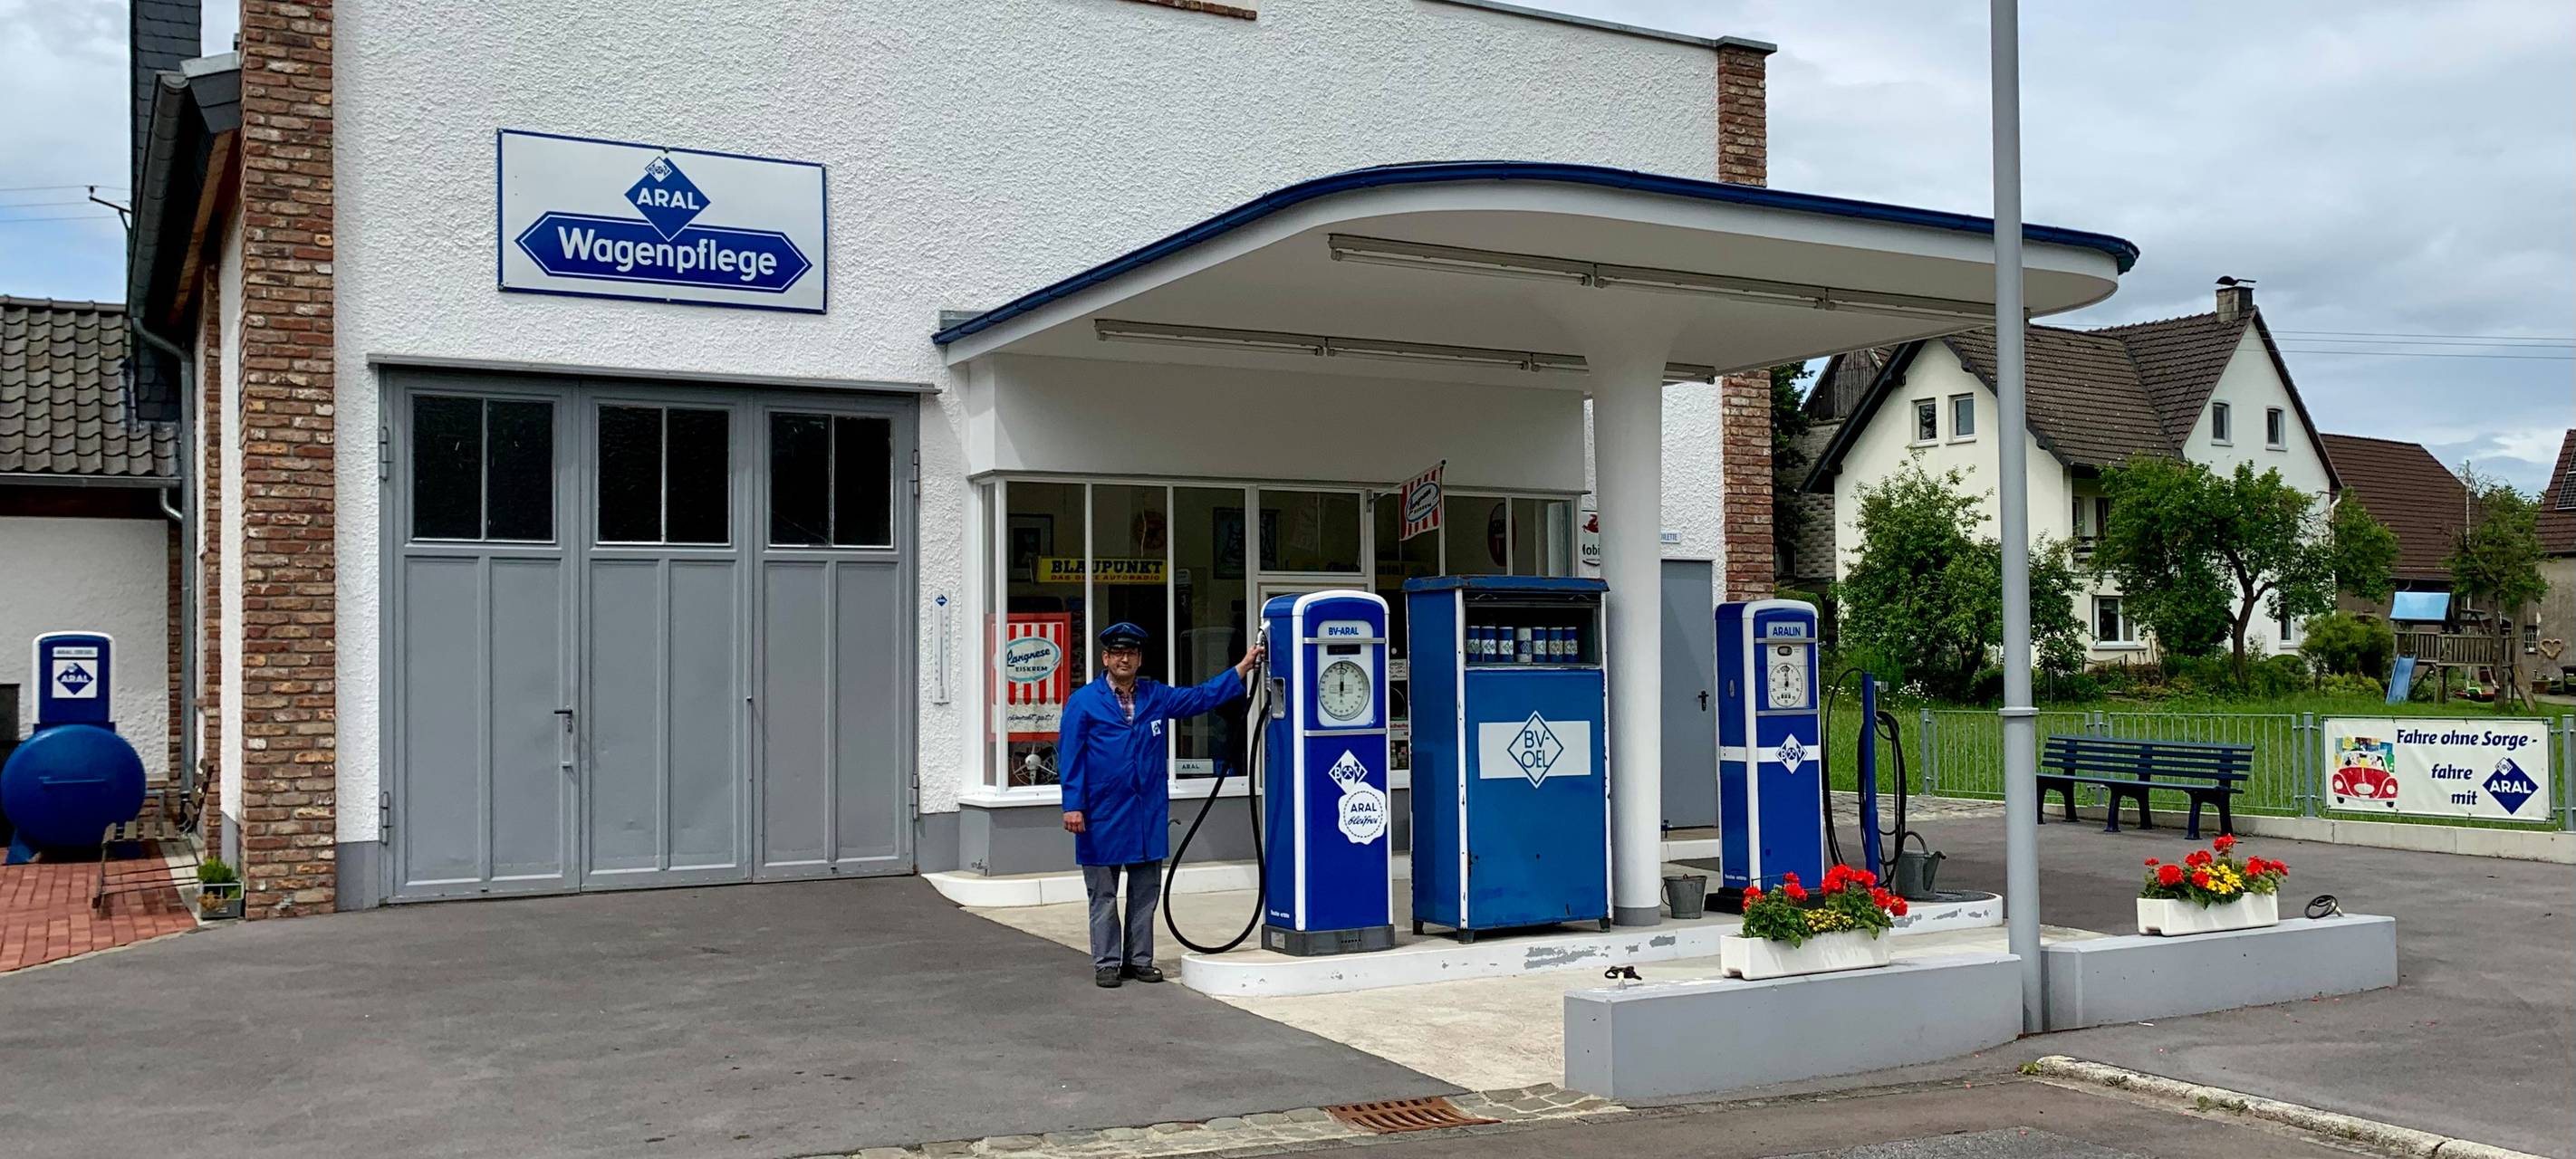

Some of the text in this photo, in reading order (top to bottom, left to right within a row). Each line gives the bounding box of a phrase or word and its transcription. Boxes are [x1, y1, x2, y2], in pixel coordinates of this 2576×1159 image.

[636, 187, 700, 210] ARAL
[557, 225, 778, 282] Wagenpflege
[1051, 560, 1163, 574] BLAUPUNKT
[1328, 627, 1359, 636] BV-ARAL
[1773, 627, 1801, 636] ARALIN
[1006, 648, 1051, 666] Langnese
[60, 675, 90, 683] ARAL
[1524, 730, 1550, 748] BV-
[2397, 729, 2437, 744] Fahre
[2440, 730, 2479, 746] ohne
[2482, 731, 2528, 751] Sorge
[1522, 750, 1550, 768] OEL
[2431, 763, 2473, 780] fahre
[2489, 780, 2533, 794] ARAL
[2451, 790, 2477, 805] mit
[1350, 802, 1377, 812] ARAL
[1348, 816, 1378, 828] bleifrei
